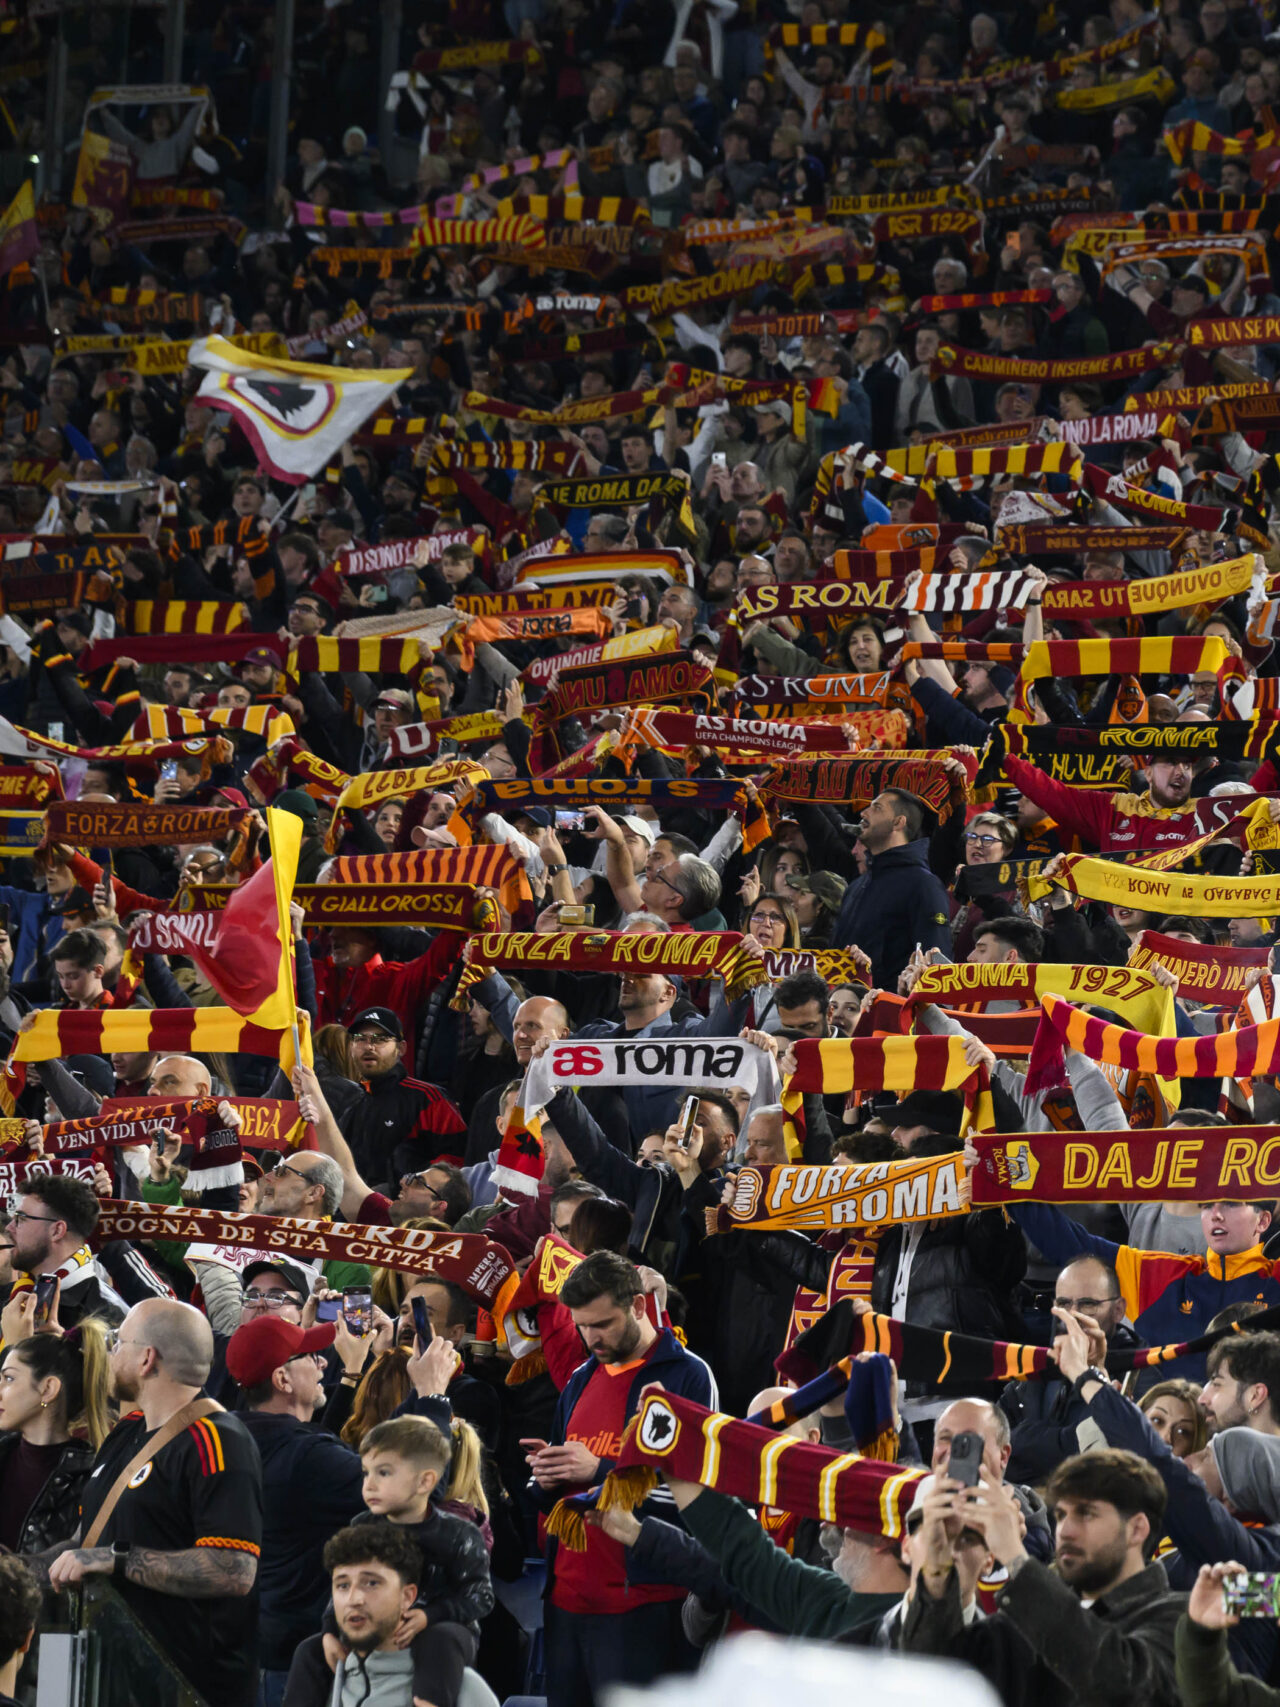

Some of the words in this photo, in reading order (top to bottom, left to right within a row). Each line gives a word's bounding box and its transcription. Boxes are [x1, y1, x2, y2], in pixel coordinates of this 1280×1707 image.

[777, 317, 821, 337] TOTTI
[1051, 359, 1110, 378] INSIEME
[1127, 350, 1145, 369] TE
[1113, 411, 1158, 441] ROMA
[576, 474, 631, 500] ROMA
[790, 578, 896, 610] ROM
[695, 714, 728, 733] AS
[748, 718, 807, 742] ROMA
[717, 734, 769, 748] CHAMPIONS
[1099, 726, 1219, 748] ROMA
[66, 811, 139, 837] FORZA
[162, 807, 231, 834] ROMA
[322, 891, 463, 916] GIALLOROSSA
[613, 932, 722, 965] ROMA
[915, 963, 1030, 993] ASROMA
[1069, 965, 1155, 1000] 1927
[552, 1044, 604, 1077] as
[615, 1042, 742, 1078] roma
[56, 1130, 97, 1150] VENI
[99, 1123, 136, 1145] VIDI
[992, 1147, 1010, 1184] ROMA
[1062, 1138, 1206, 1189] DAJE
[771, 1162, 889, 1209] FORZA
[830, 1162, 962, 1224] ROMA
[218, 1222, 255, 1242] DE
[273, 1214, 464, 1258] MERDA
[467, 1252, 497, 1287] IMPERO
